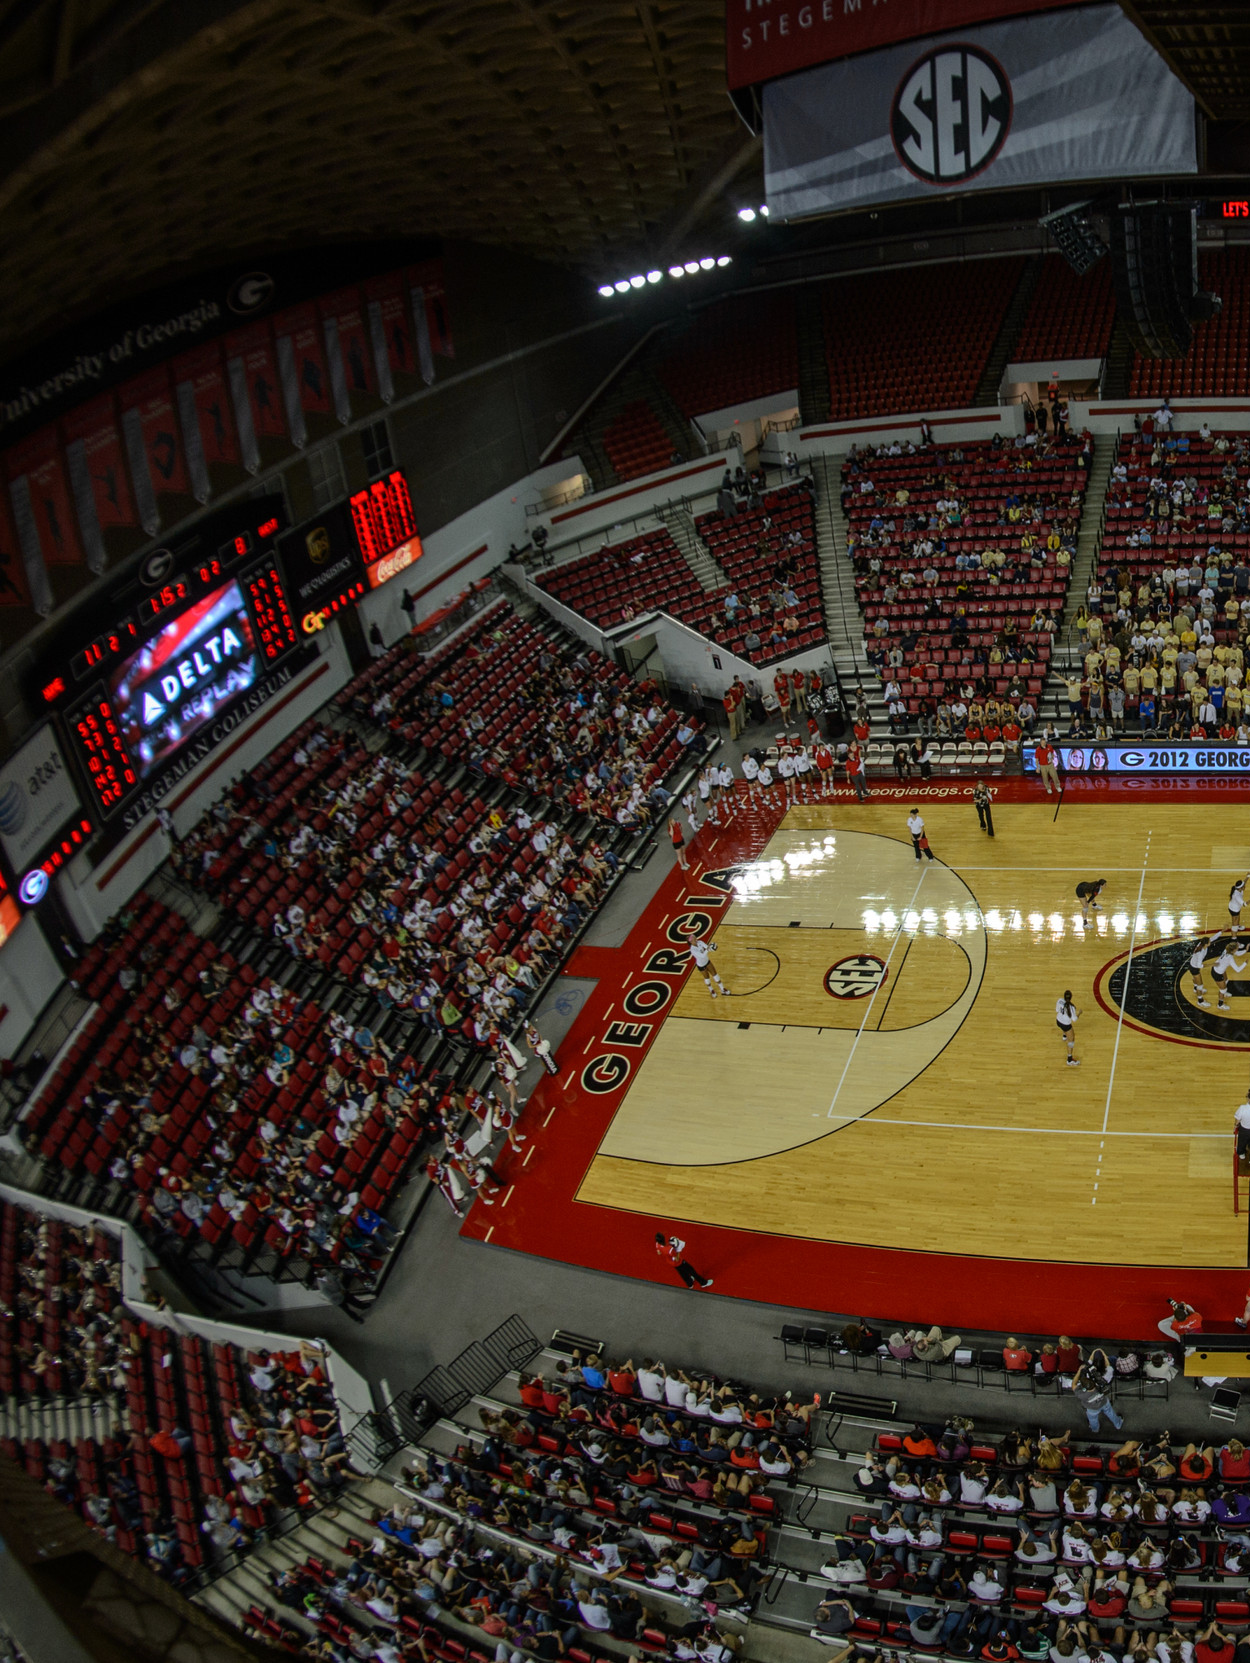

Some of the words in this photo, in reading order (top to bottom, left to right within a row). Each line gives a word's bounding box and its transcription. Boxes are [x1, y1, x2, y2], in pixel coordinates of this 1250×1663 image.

[899, 50, 1002, 177] SEC
[1223, 201, 1249, 217] LET'S
[0, 352, 105, 428] niversity
[108, 328, 138, 363] of
[136, 299, 220, 350] Georgia
[160, 627, 242, 704] DELTA
[181, 653, 257, 721] REPLAY
[27, 750, 63, 797] at&t
[122, 737, 211, 830] STEGEMAN
[211, 665, 294, 743] COLISEUM
[1148, 752, 1189, 767] 2012
[581, 865, 744, 1094] GEORGIA
[824, 955, 888, 999] SEC
